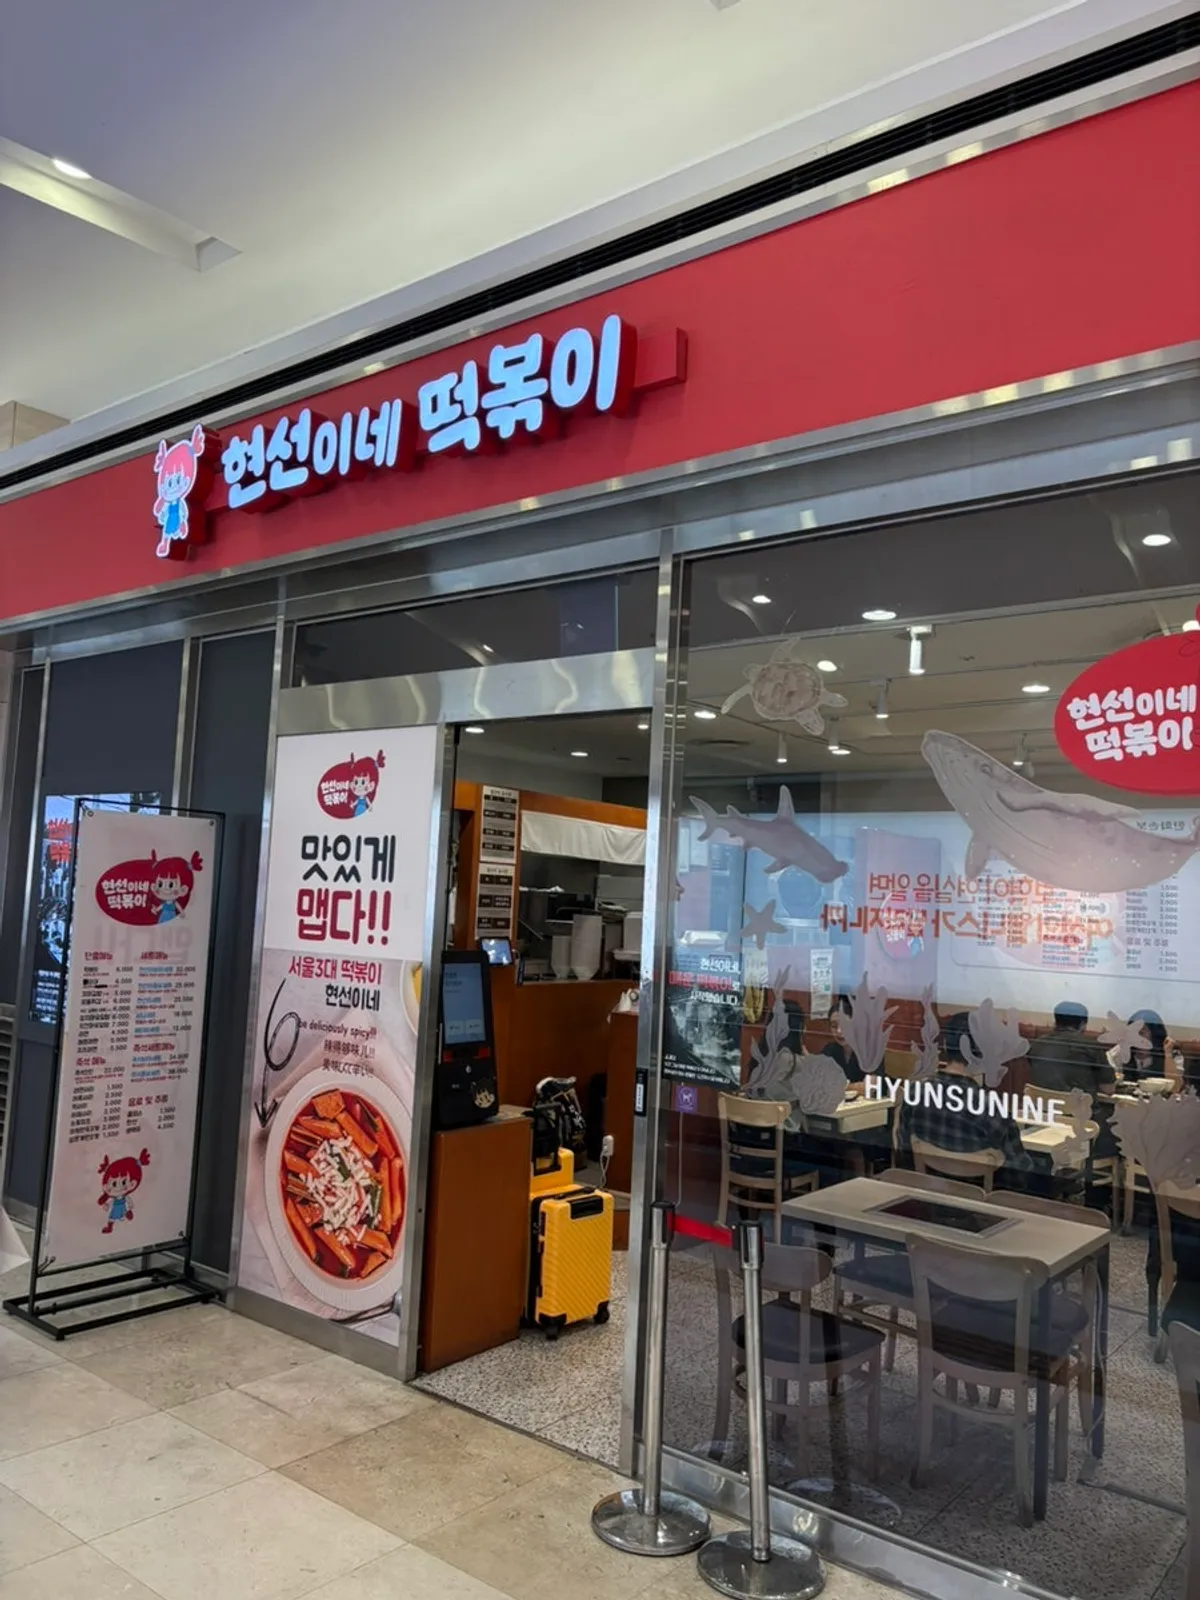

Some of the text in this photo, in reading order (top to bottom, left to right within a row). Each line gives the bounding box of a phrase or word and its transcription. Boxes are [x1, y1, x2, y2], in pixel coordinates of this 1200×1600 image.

[220, 314, 622, 509] 현선이네 떡볶이
[1067, 684, 1196, 730] 현선이네
[1085, 716, 1194, 761] 떡볶이
[321, 779, 349, 795] 현선이네
[324, 792, 348, 806] 떡볶이
[301, 834, 396, 883] 맛있게
[101, 878, 150, 895] 현선이네
[107, 893, 147, 910] 떡볶이
[297, 887, 391, 945] 맵다!!
[288, 956, 382, 985] 서울3대 떡볶이
[325, 984, 380, 1012] 현선이네
[309, 1019, 348, 1037] deliciously
[865, 1074, 1066, 1123] HYUNSUNINE
